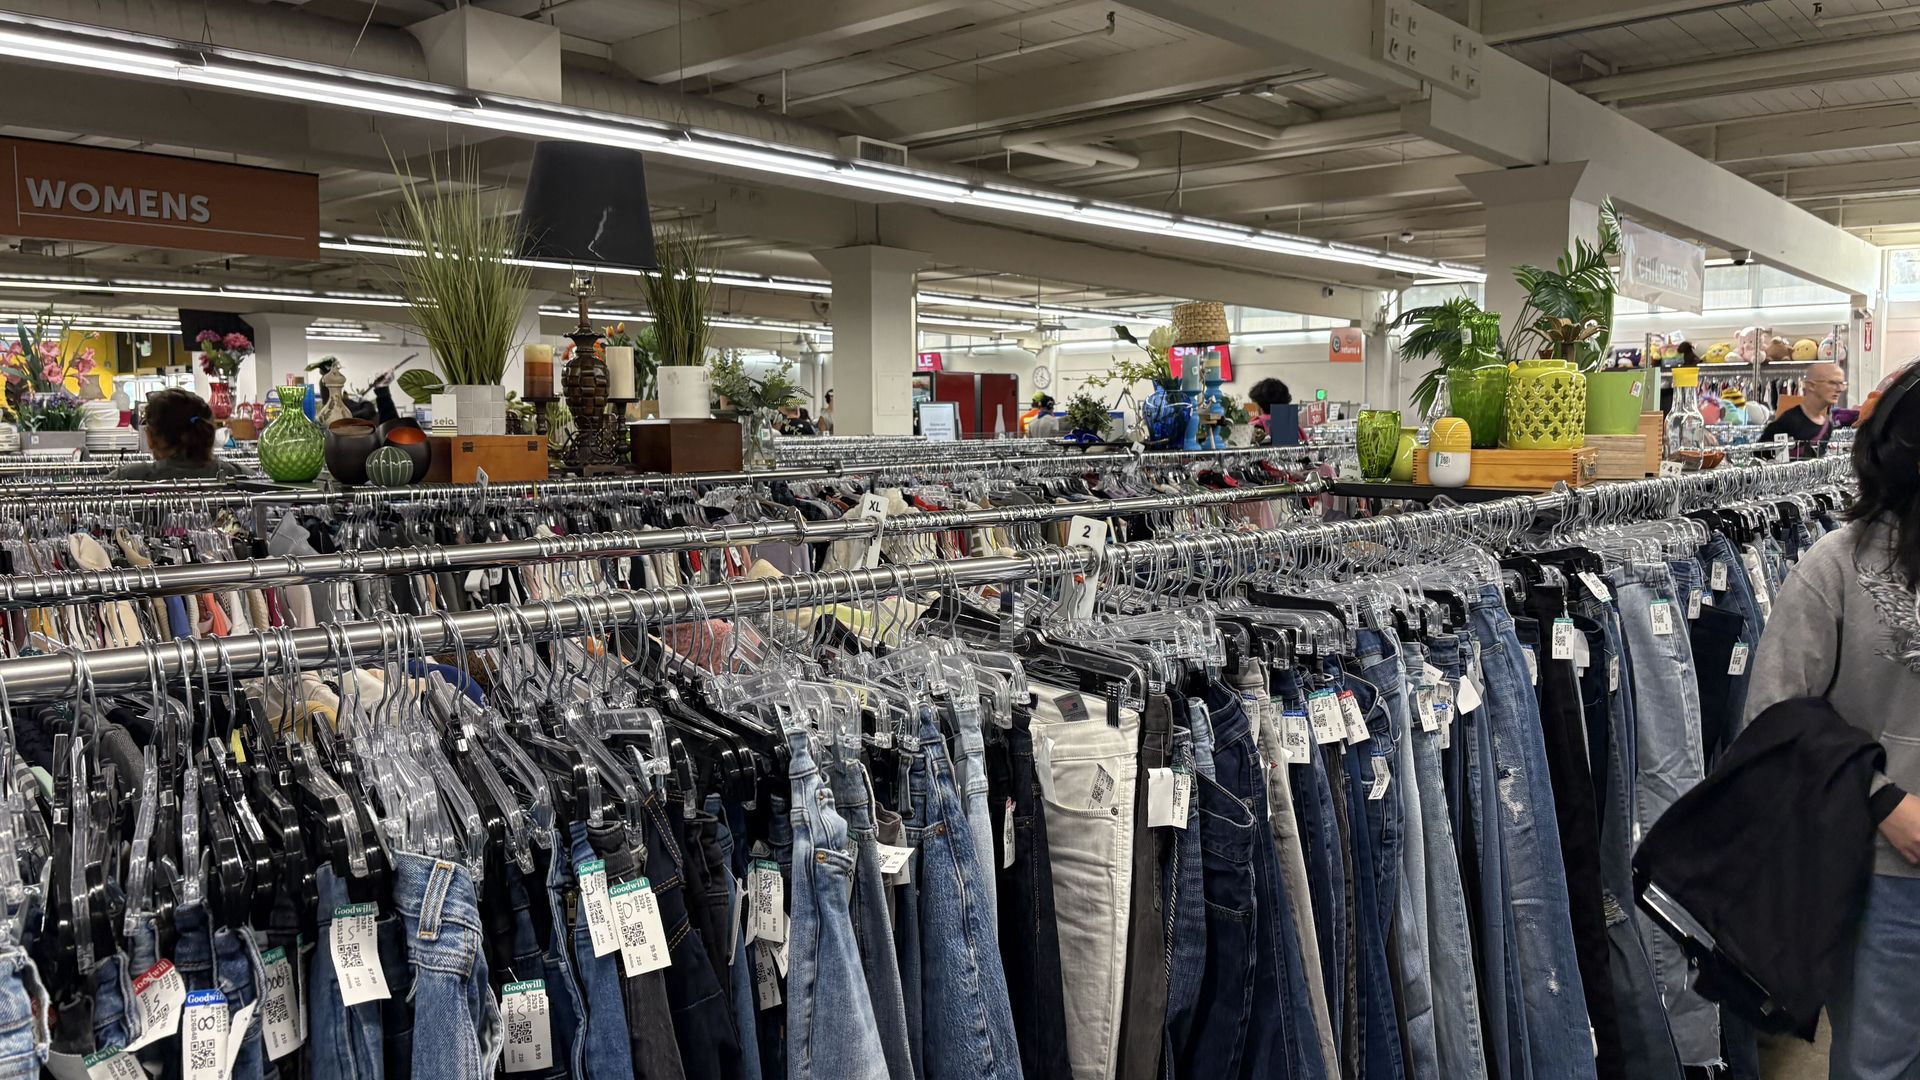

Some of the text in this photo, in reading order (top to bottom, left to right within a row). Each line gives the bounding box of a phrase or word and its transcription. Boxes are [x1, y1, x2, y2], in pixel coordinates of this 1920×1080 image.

[25, 177, 211, 224] WOMENS
[917, 354, 934, 367] LE
[1310, 402, 1323, 413] SALE
[434, 417, 455, 425] sela
[868, 500, 881, 513] XL
[1082, 524, 1091, 539] 2
[610, 879, 646, 895] Goodwill
[335, 903, 373, 916] Goodwill
[638, 895, 646, 909] 2529
[644, 892, 653, 915] LADIES
[169, 970, 180, 991] LADIES
[504, 980, 542, 992] Goodwill
[85, 1046, 119, 1065] odwill
[113, 1059, 127, 1077] 2529
[121, 1054, 139, 1080] LADIES
